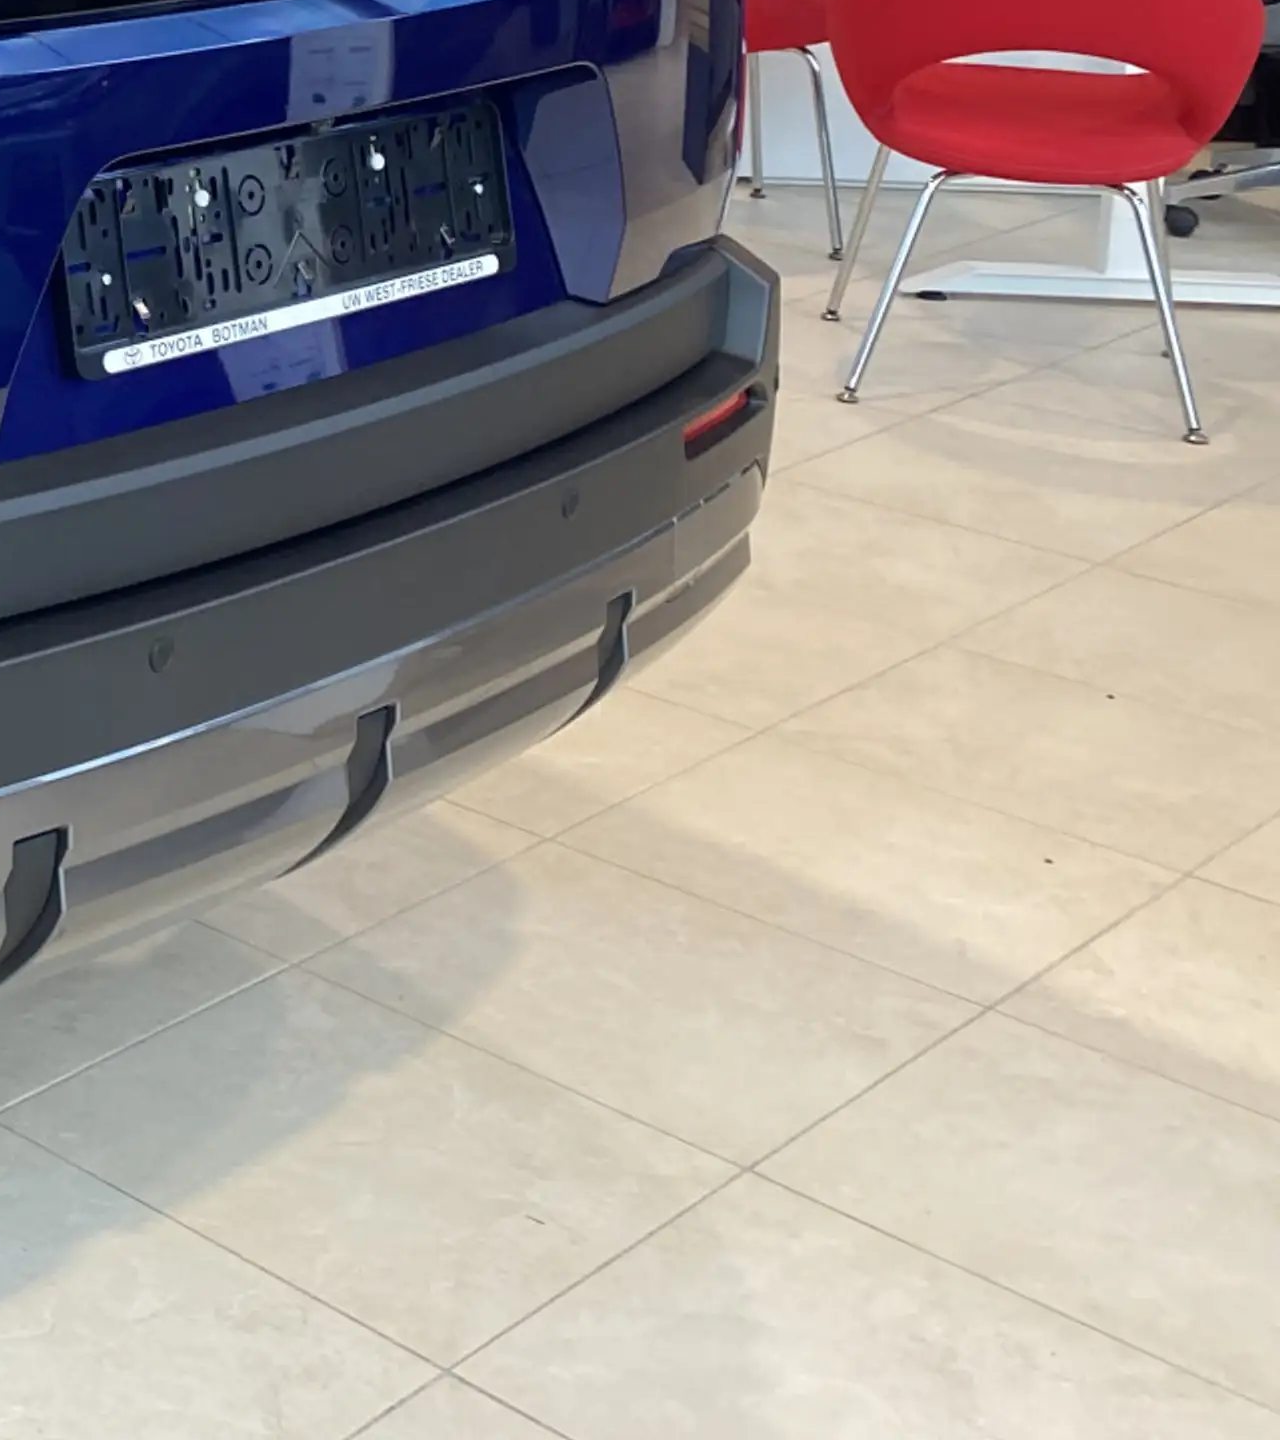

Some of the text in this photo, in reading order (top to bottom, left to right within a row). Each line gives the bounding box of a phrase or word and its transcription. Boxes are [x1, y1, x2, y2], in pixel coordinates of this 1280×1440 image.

[148, 333, 204, 359] TOYOTA
[211, 316, 269, 344] BOTMAN
[364, 272, 440, 301] WEST-FRIESE
[441, 260, 484, 284] DEALER
